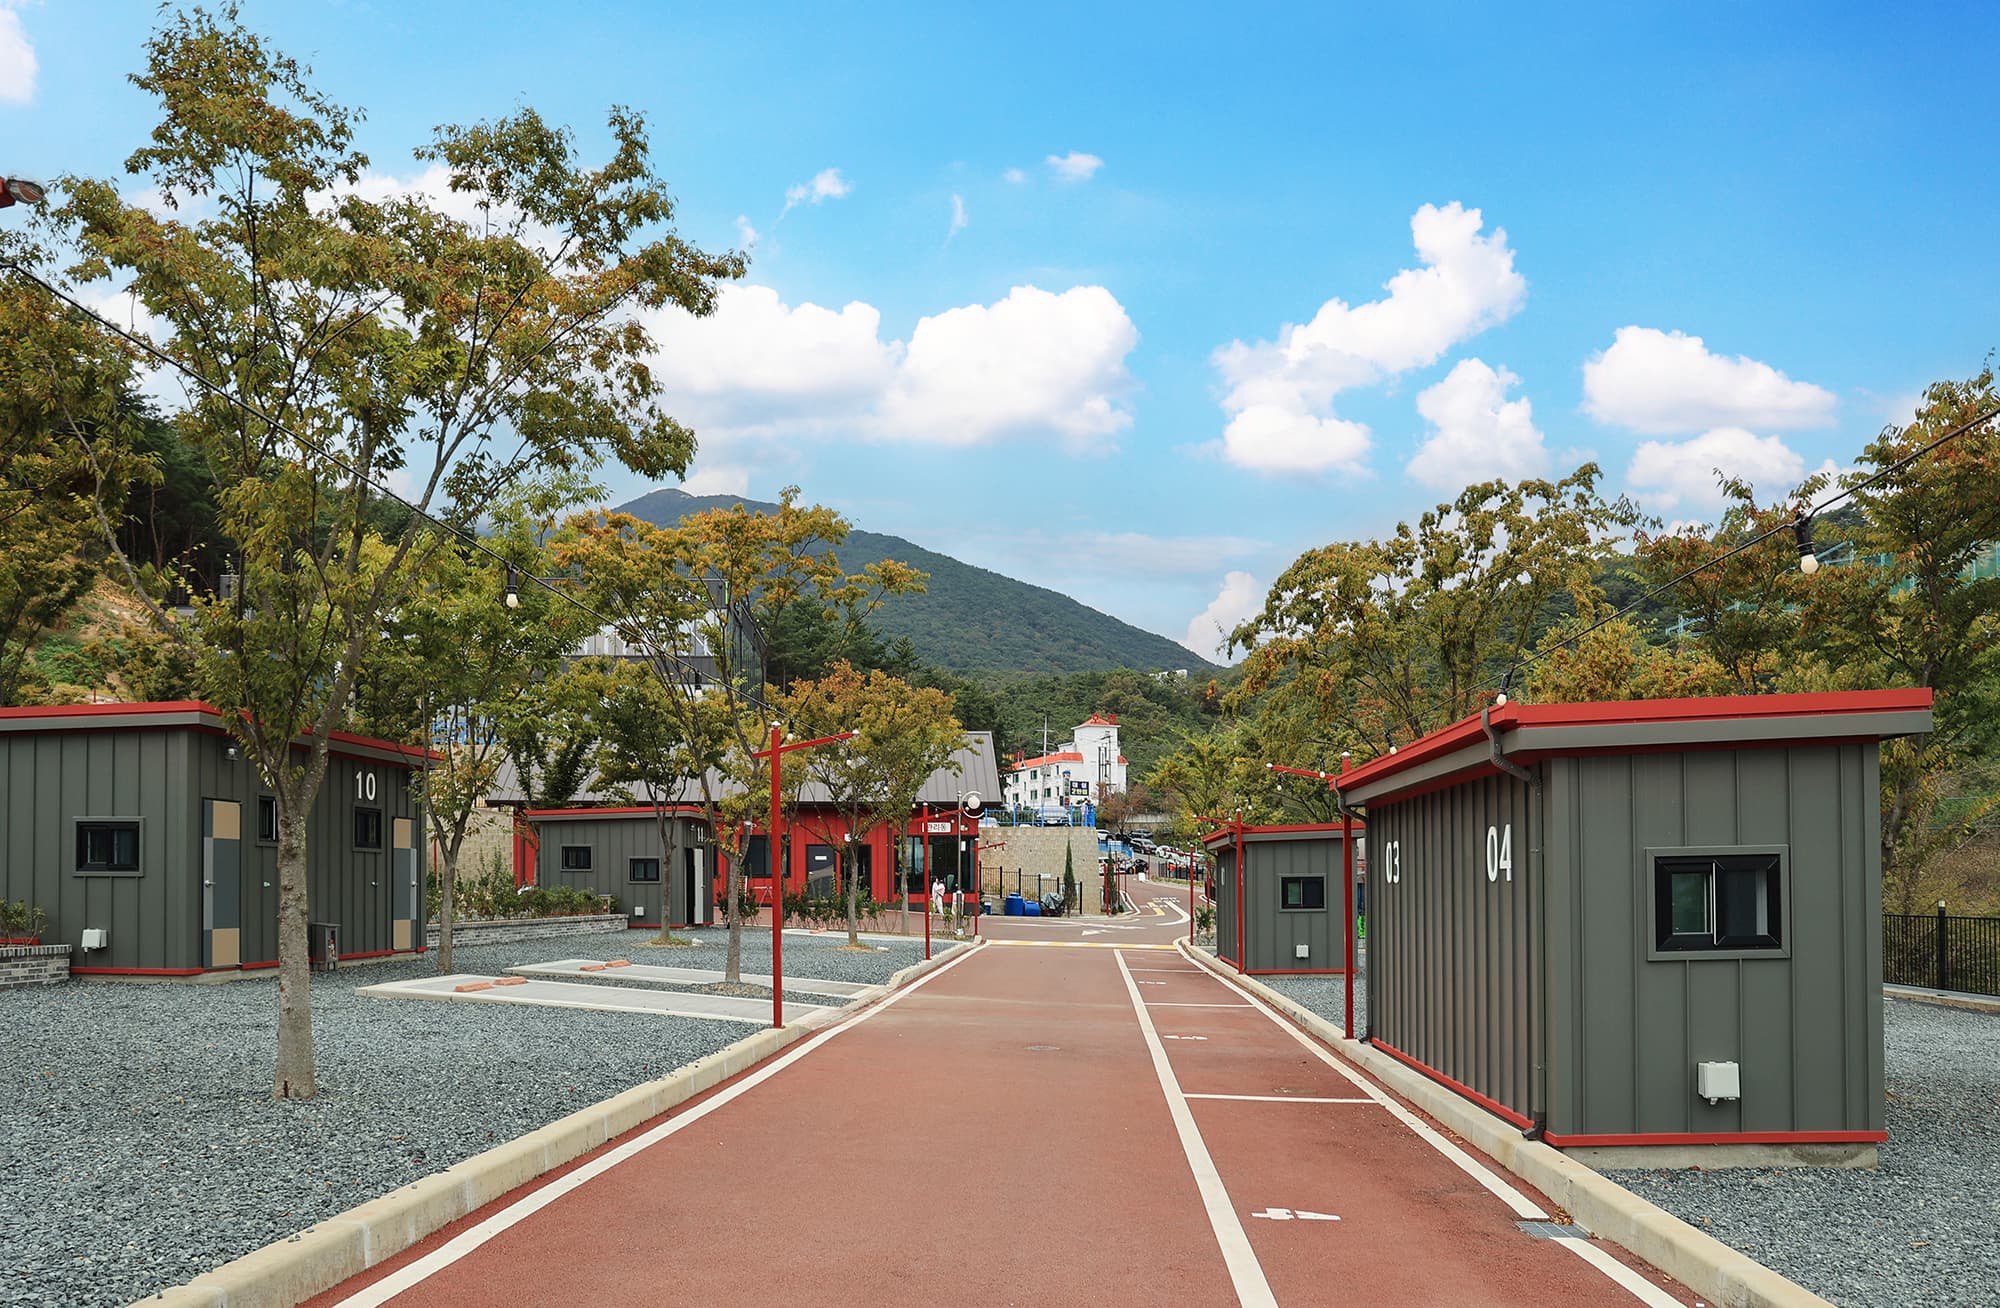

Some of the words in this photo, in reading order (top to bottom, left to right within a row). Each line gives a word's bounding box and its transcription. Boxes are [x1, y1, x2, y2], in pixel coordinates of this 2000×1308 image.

[356, 771, 376, 801] 10
[1385, 840, 1400, 884] 03
[1486, 823, 1512, 882] 04
